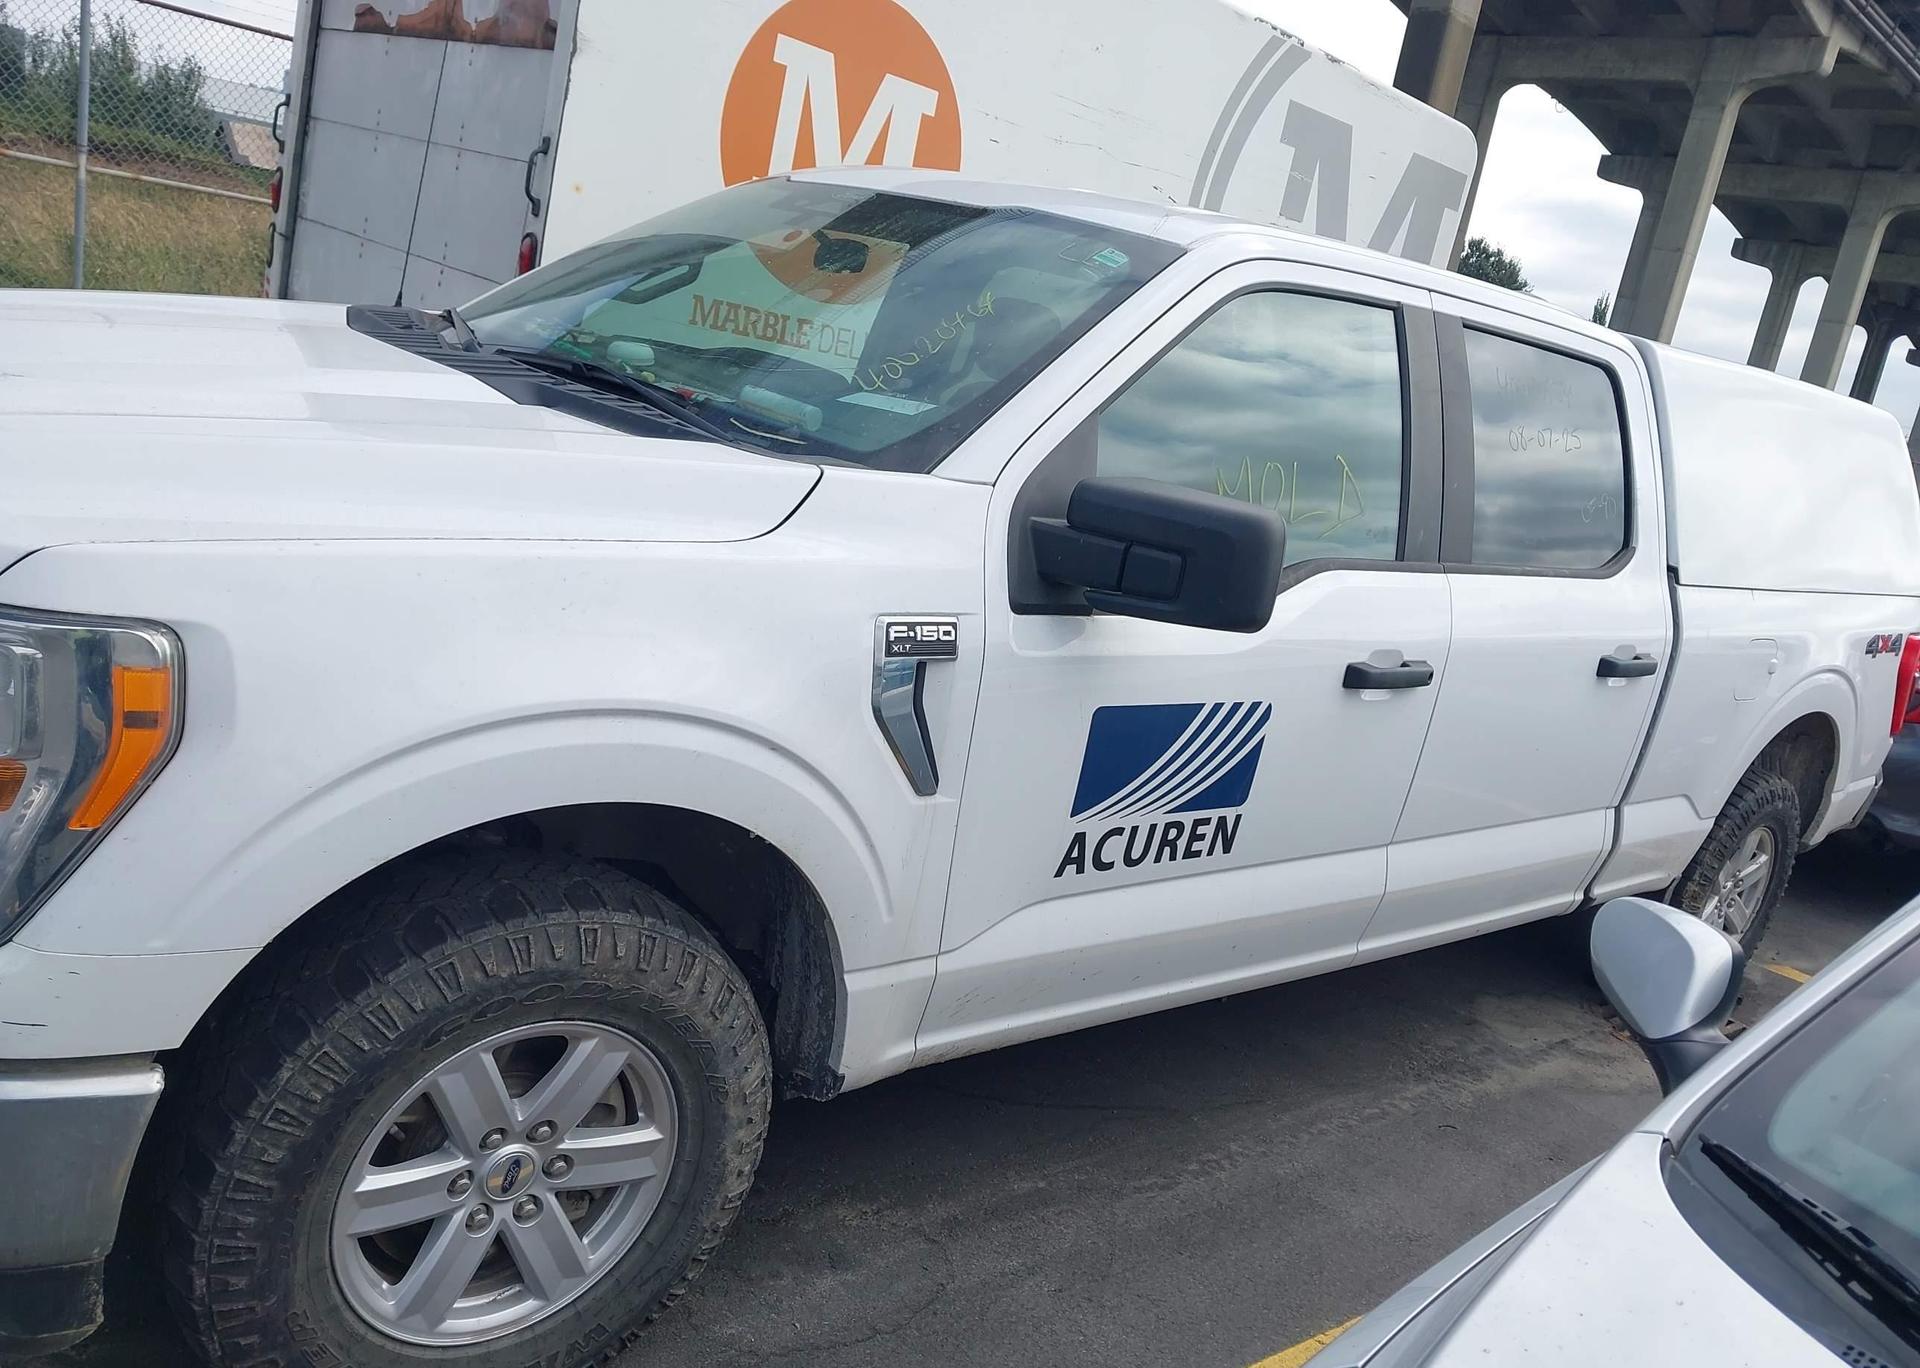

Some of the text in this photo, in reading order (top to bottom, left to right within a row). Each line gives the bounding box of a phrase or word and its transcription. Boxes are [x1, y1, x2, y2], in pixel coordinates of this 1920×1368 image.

[688, 294, 814, 350] MARBLE
[1216, 453, 1365, 540] MOLD
[888, 625, 956, 641] F-150
[891, 644, 912, 653] XLT
[1053, 813, 1243, 878] ACUREN
